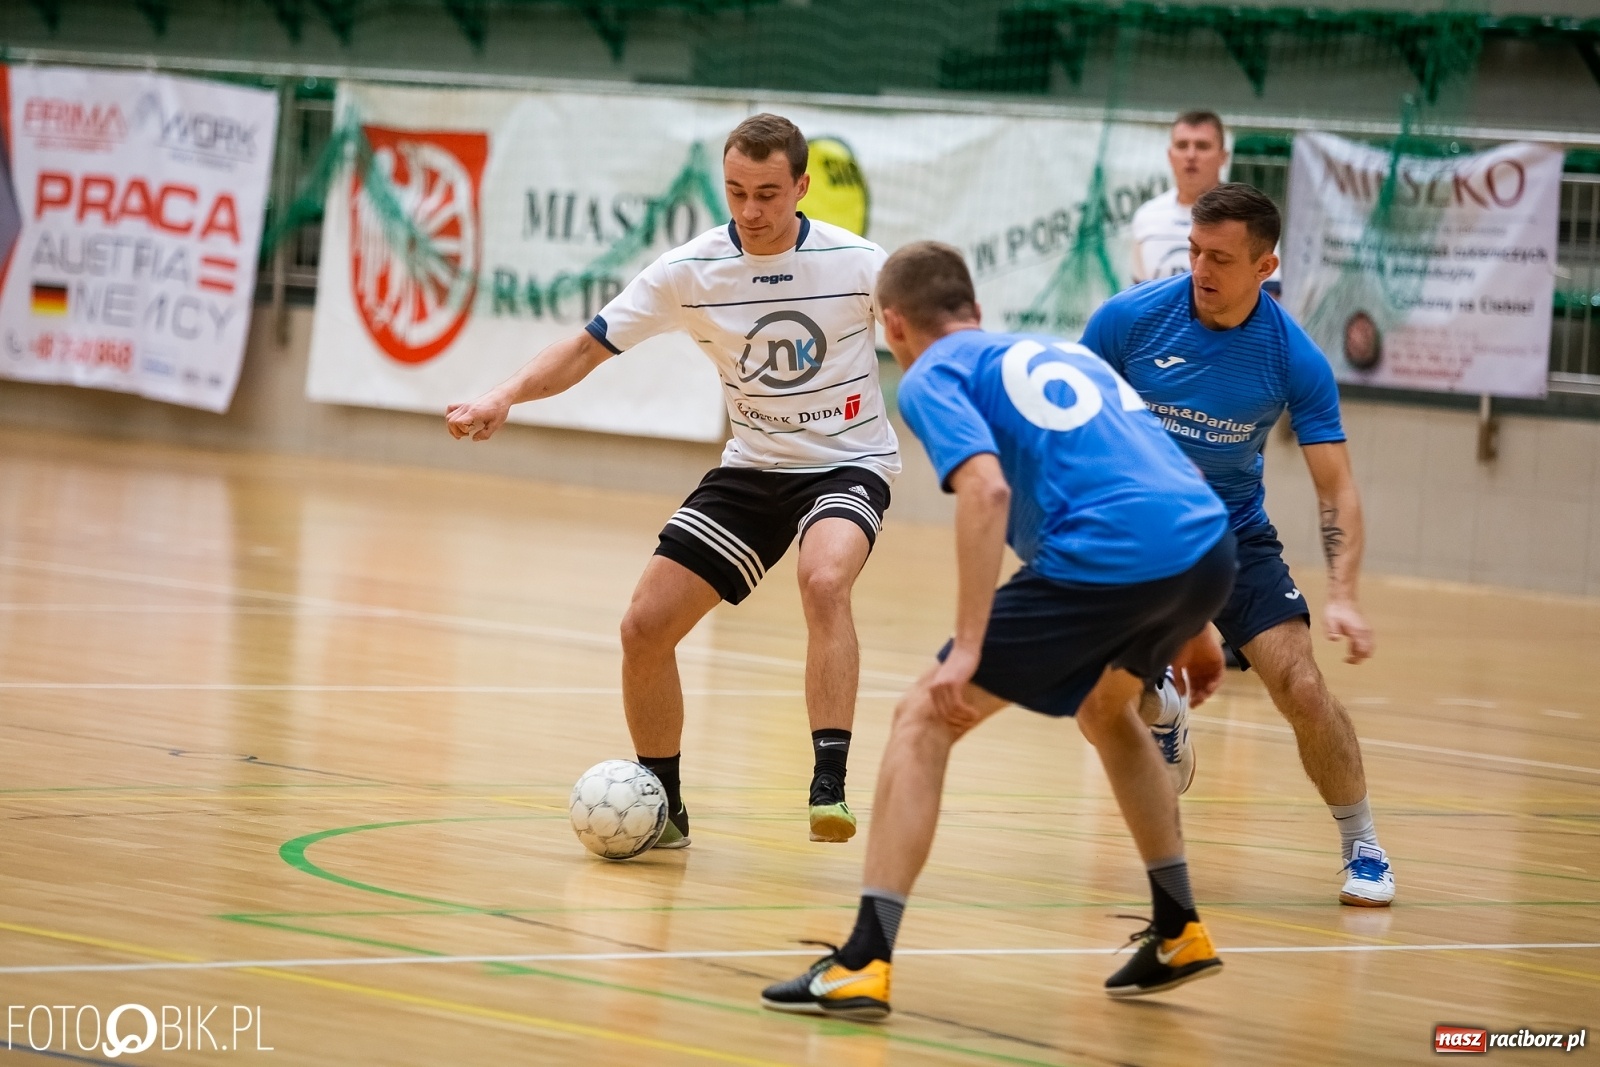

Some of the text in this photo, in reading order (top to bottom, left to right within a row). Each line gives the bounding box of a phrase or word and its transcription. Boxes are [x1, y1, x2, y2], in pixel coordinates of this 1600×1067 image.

[34, 168, 243, 246] PRACA
[1321, 150, 1526, 210] MISZKO
[521, 183, 702, 248] MIASTO
[30, 230, 192, 283] AUSTRIA
[752, 273, 794, 285] regio
[490, 268, 622, 326] RACIB
[798, 407, 843, 425] DUDA
[1143, 400, 1256, 433] arek&Darius
